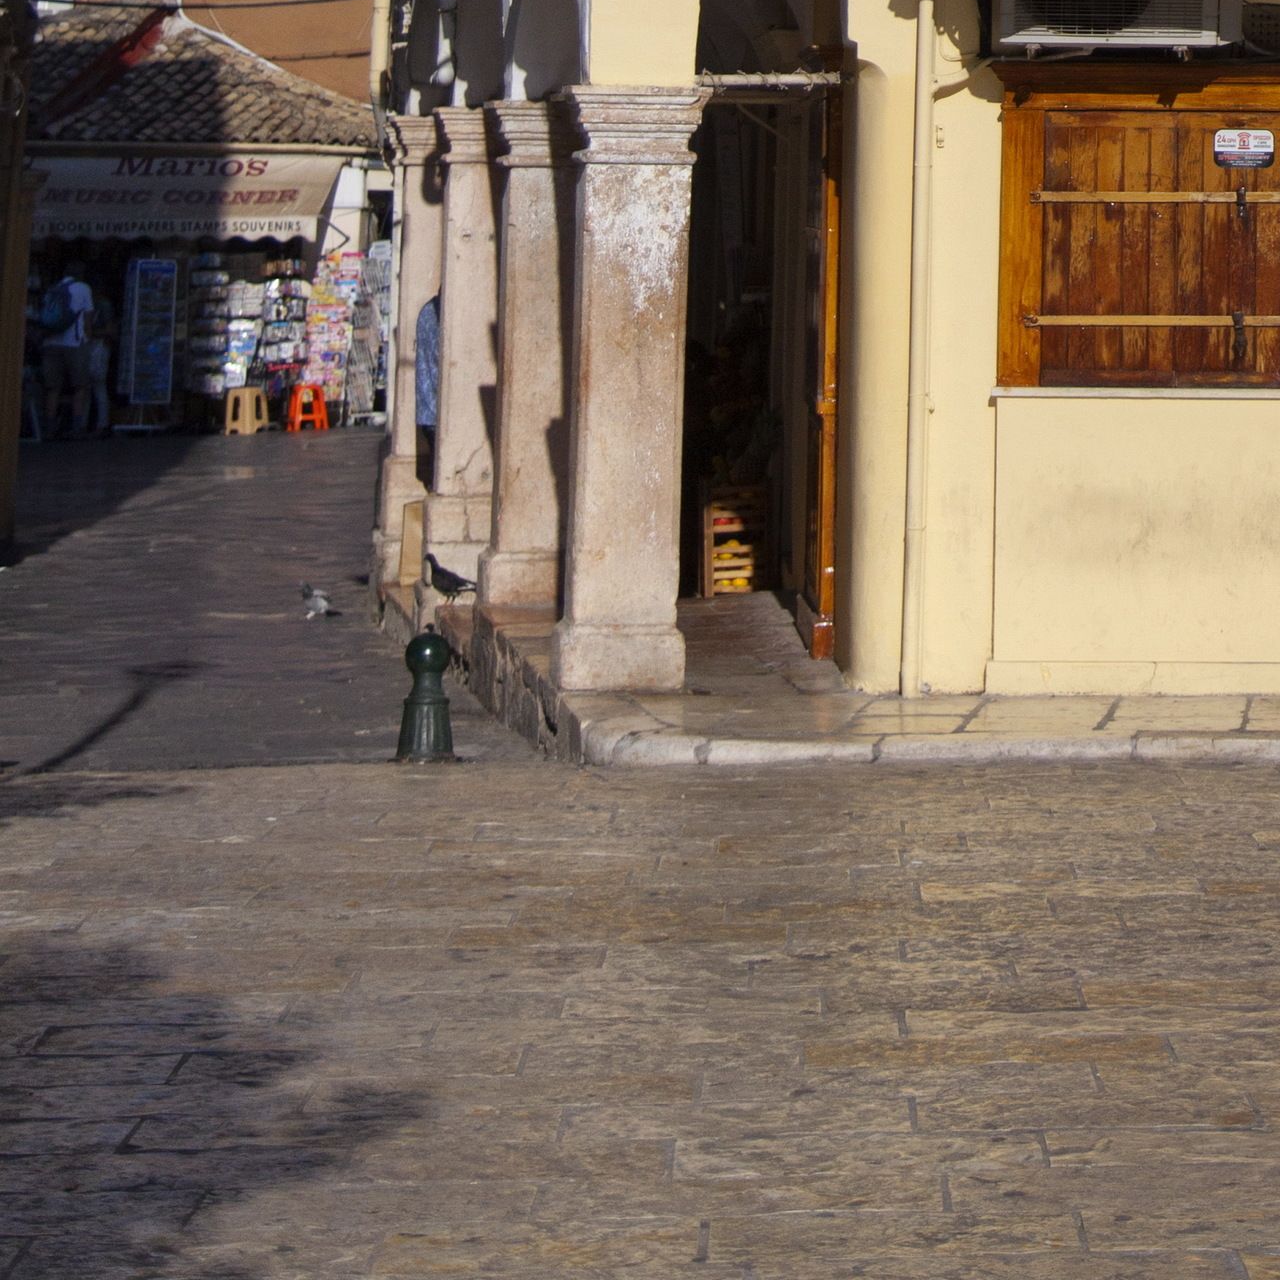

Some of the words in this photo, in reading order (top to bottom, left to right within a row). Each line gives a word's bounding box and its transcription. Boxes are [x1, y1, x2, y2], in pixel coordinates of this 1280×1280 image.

[111, 155, 269, 177] Mario's
[42, 189, 153, 204] MUSIC
[162, 188, 300, 205] CORNER
[48, 221, 92, 233] BOOKS
[95, 221, 176, 233] NEWSPAPERS
[181, 221, 228, 233] STAMPS
[231, 220, 302, 233] SOUVENIRS
